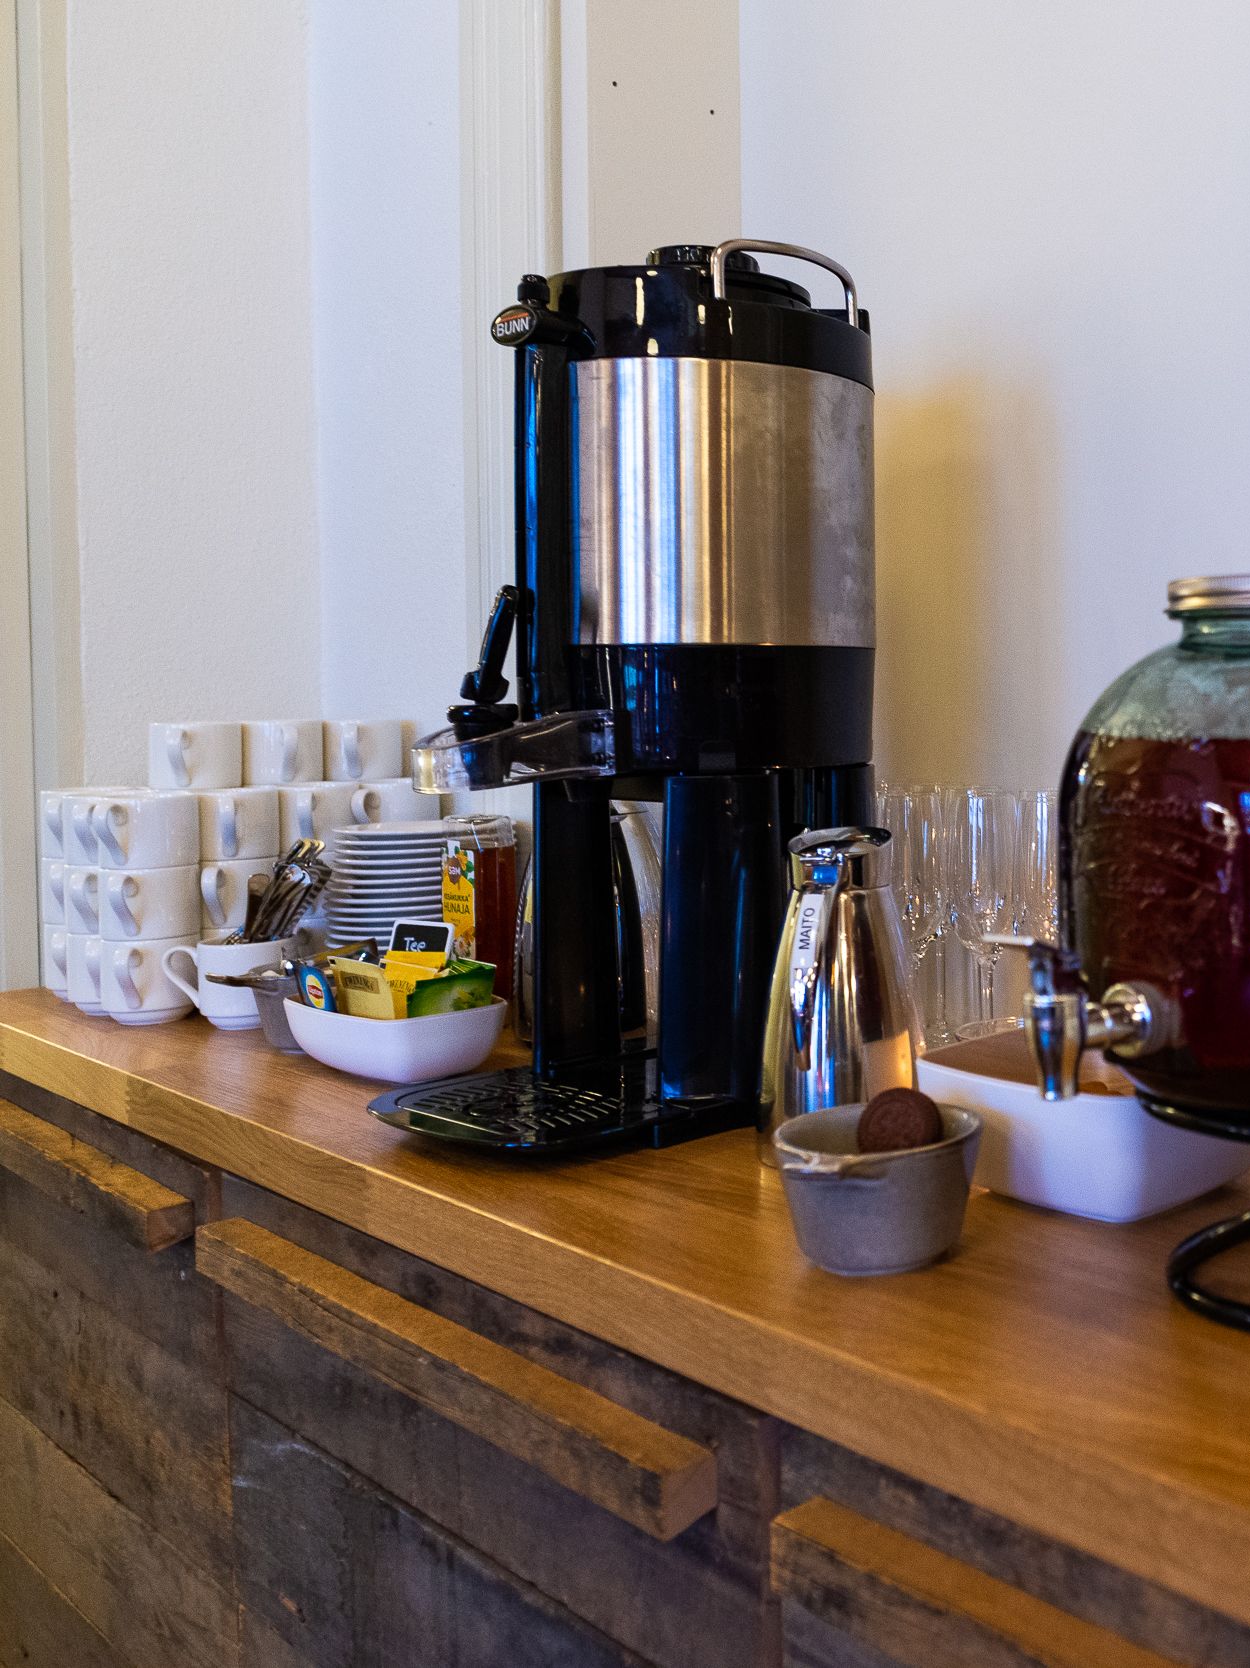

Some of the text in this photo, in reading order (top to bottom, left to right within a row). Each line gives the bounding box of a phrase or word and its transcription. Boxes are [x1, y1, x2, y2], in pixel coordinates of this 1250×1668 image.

[496, 316, 529, 337] BUNN
[799, 907, 815, 950] MAITO
[404, 937, 426, 952] Tee
